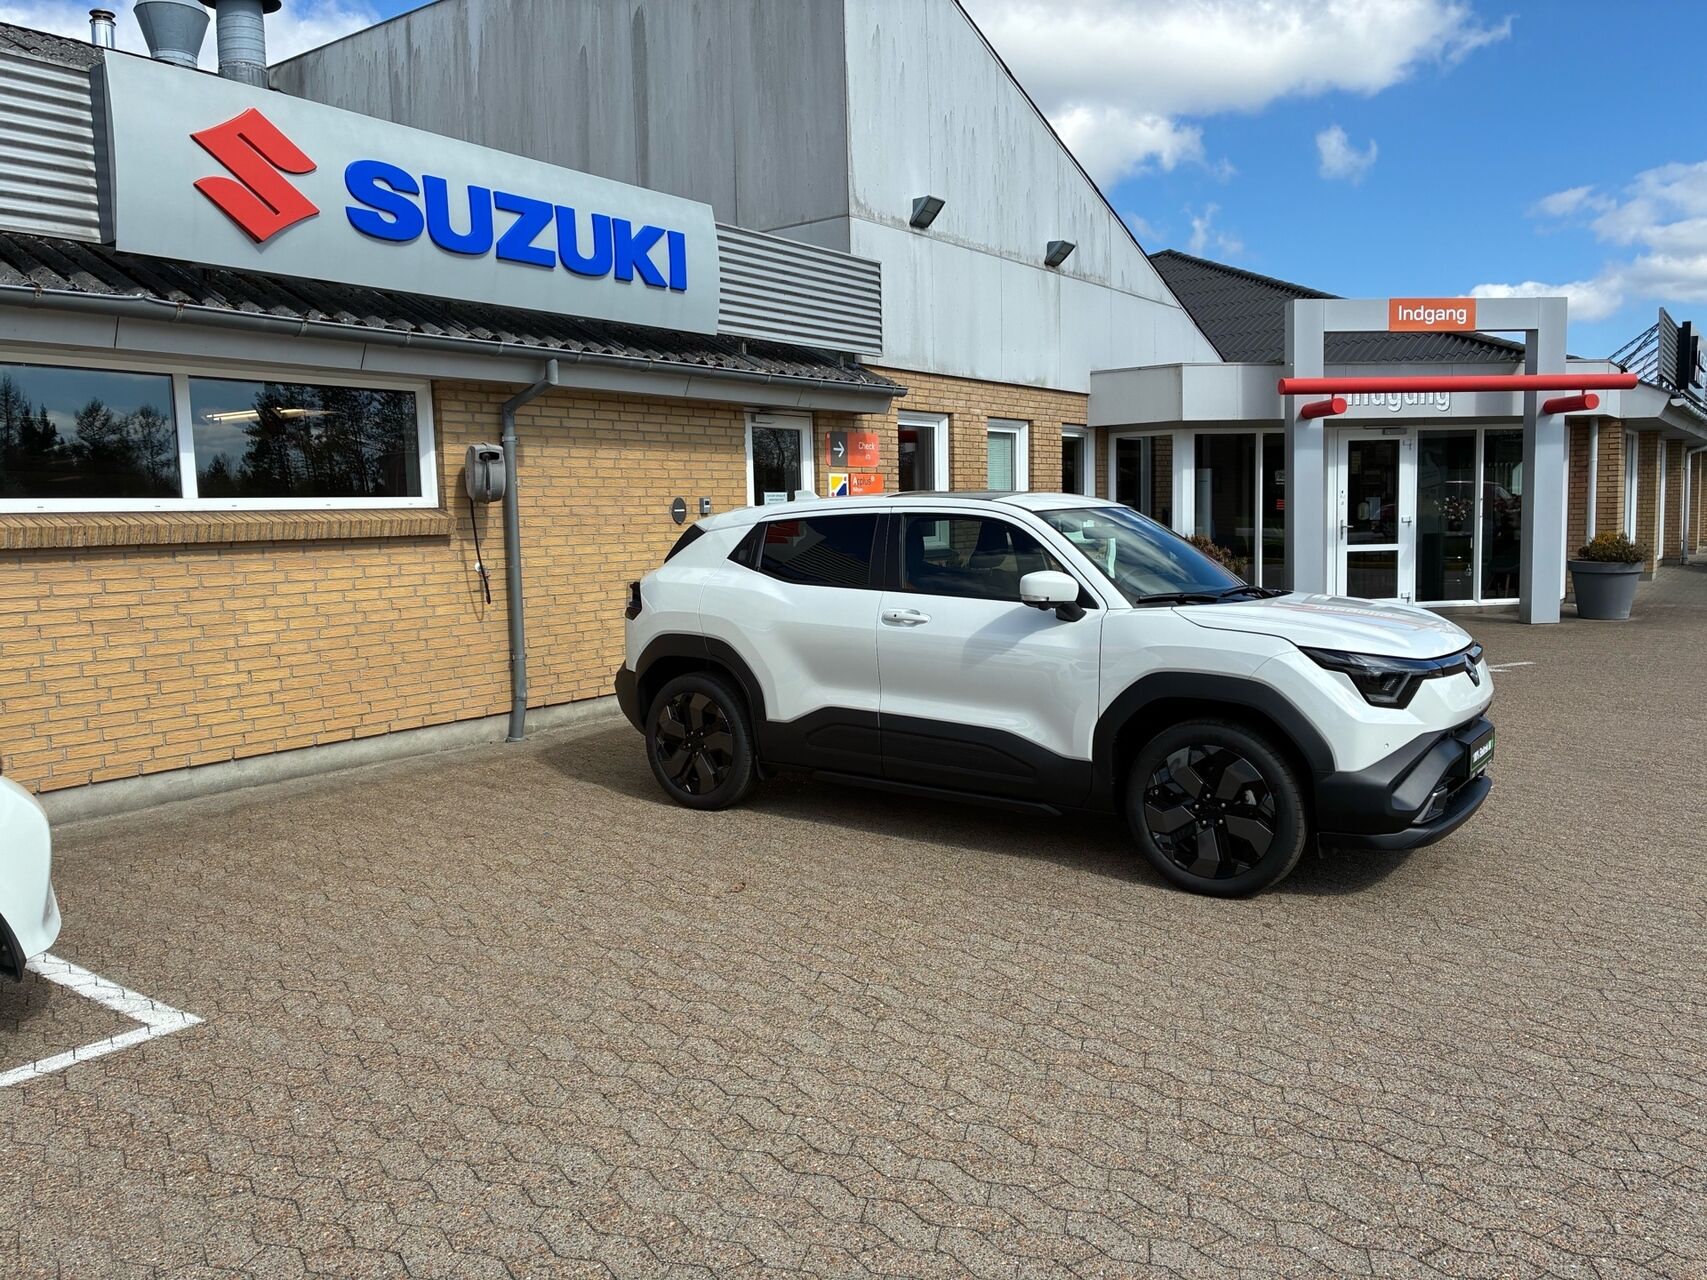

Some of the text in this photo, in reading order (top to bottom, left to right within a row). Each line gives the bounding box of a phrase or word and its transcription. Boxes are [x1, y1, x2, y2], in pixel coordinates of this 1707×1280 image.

[345, 160, 687, 291] SUZUKI
[1398, 305, 1467, 325] Indgang
[858, 442, 875, 450] Check
